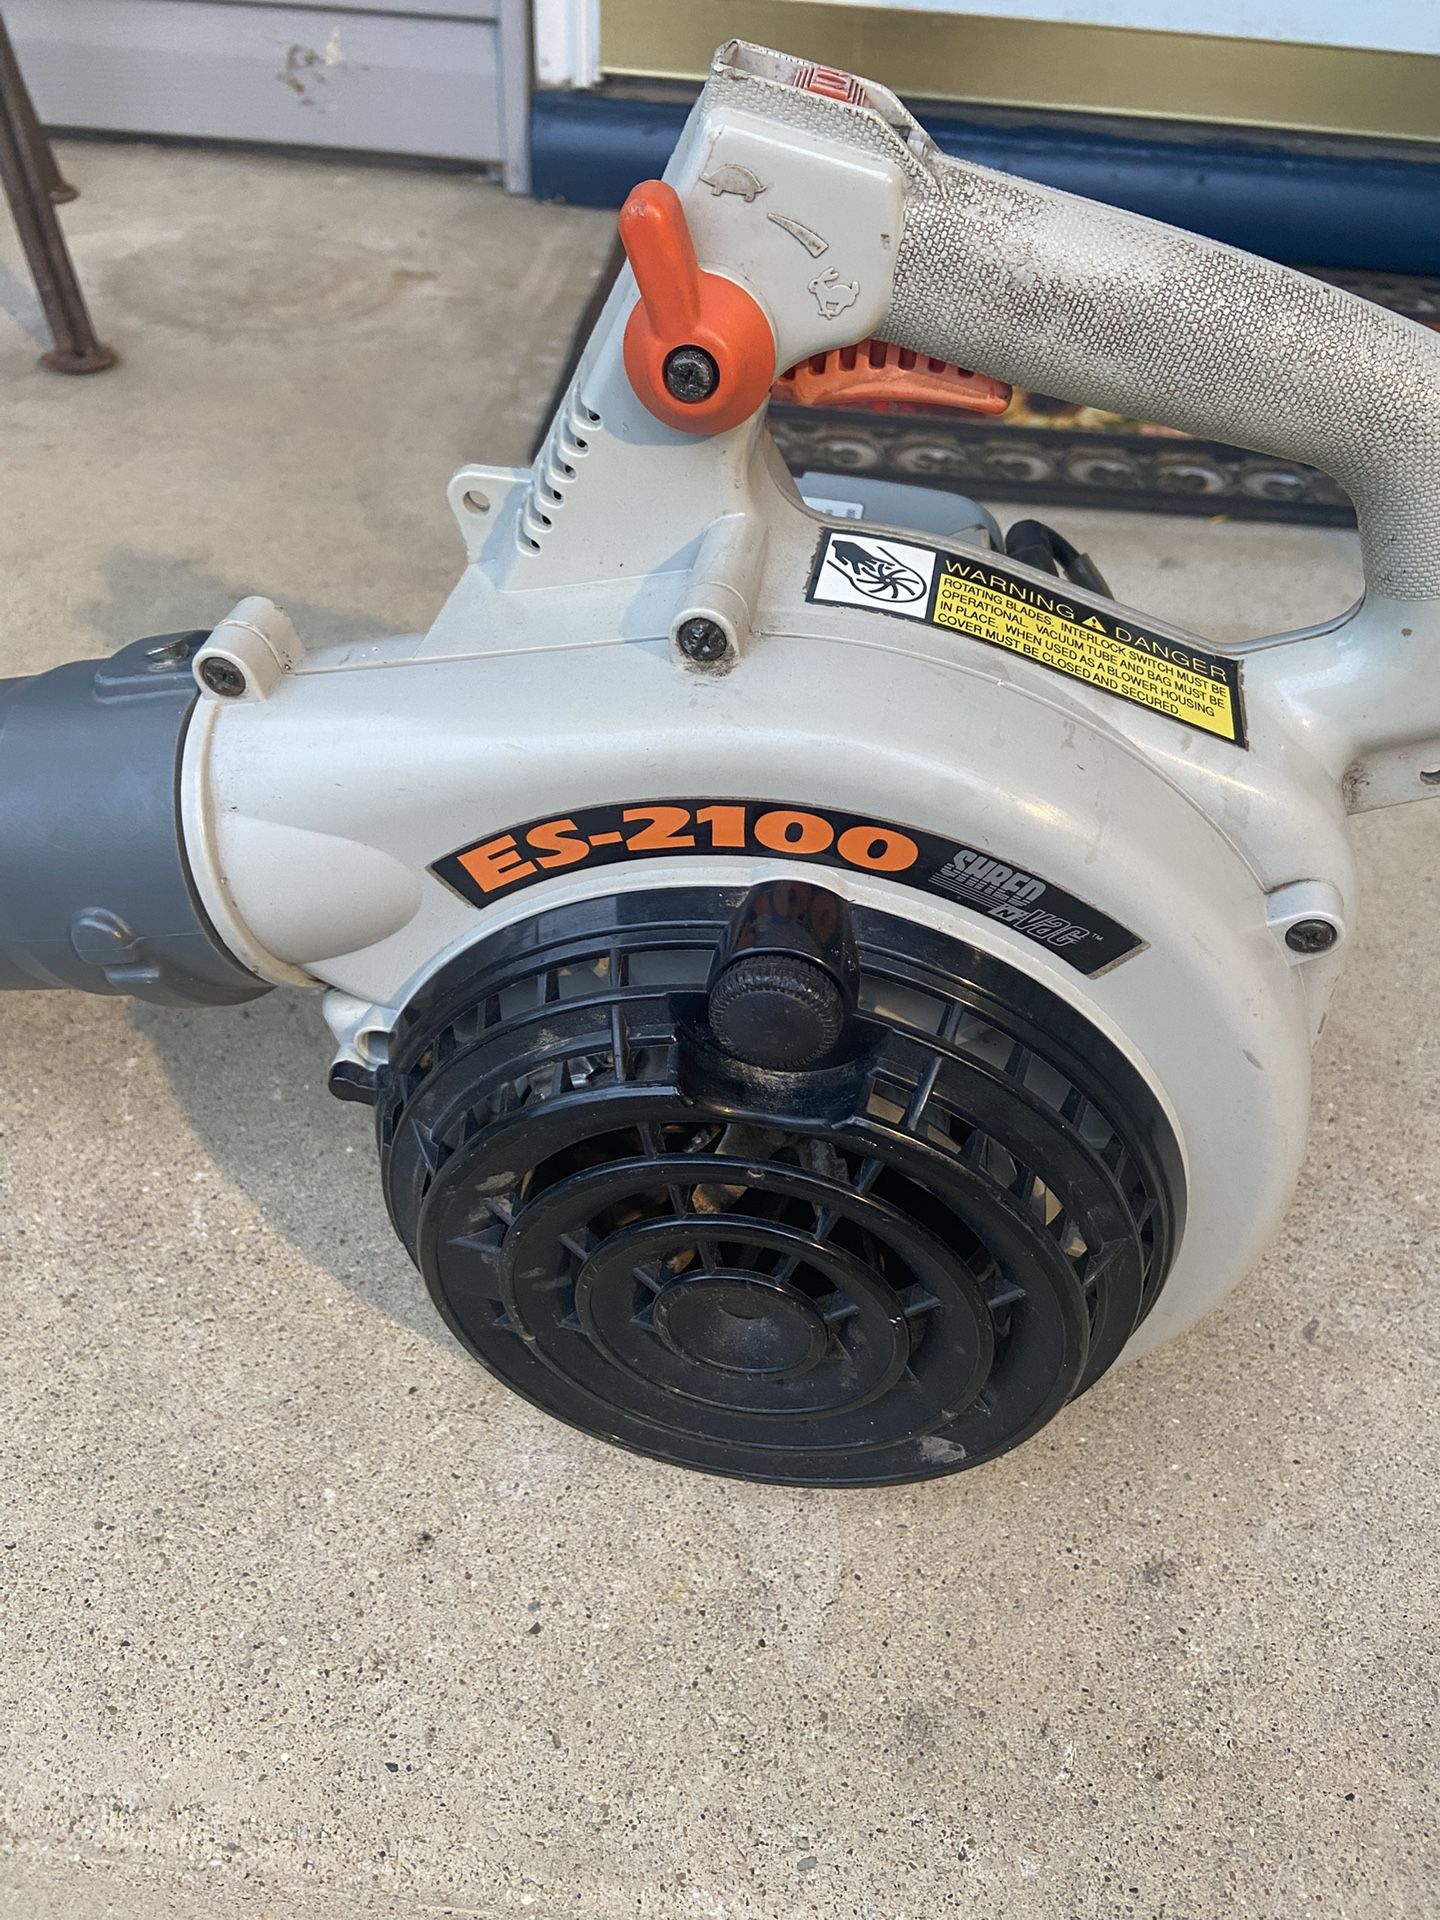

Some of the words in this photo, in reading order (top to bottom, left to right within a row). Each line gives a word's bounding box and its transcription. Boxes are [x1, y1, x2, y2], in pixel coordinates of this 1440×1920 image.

[937, 612, 982, 635] COVER
[985, 628, 1021, 649] MUST
[1023, 643, 1040, 658] BE
[1042, 651, 1091, 679] CLOSED
[1092, 673, 1118, 690] AND
[1121, 684, 1182, 717] SECURED.
[940, 600, 953, 613] IN
[955, 605, 998, 629] PLACE.
[1005, 623, 1042, 646] WHEN
[1045, 639, 1078, 660] USED
[1079, 654, 1095, 668] AS
[1096, 662, 1106, 673] A
[1107, 665, 1158, 694] BLOWER
[1160, 687, 1215, 717] HOUSING
[942, 589, 1029, 628] OPERATIONAL.
[1036, 623, 1084, 650] VACUUM
[1087, 645, 1118, 666] TUBE
[1119, 659, 1145, 675] AND
[1147, 671, 1171, 687] BAG
[1174, 681, 1207, 700] MUST
[1209, 695, 1225, 709] BE
[943, 577, 1003, 605] ROTATING
[1005, 600, 1055, 627] BLADES.
[1060, 622, 1127, 657] INTERLOCK
[1129, 650, 1174, 676] SWITCH
[1176, 670, 1208, 689] MUST
[1211, 683, 1227, 697] BE
[945, 559, 1075, 620] WARNING
[1115, 626, 1227, 682] DANGER
[456, 805, 919, 893] ES-2100
